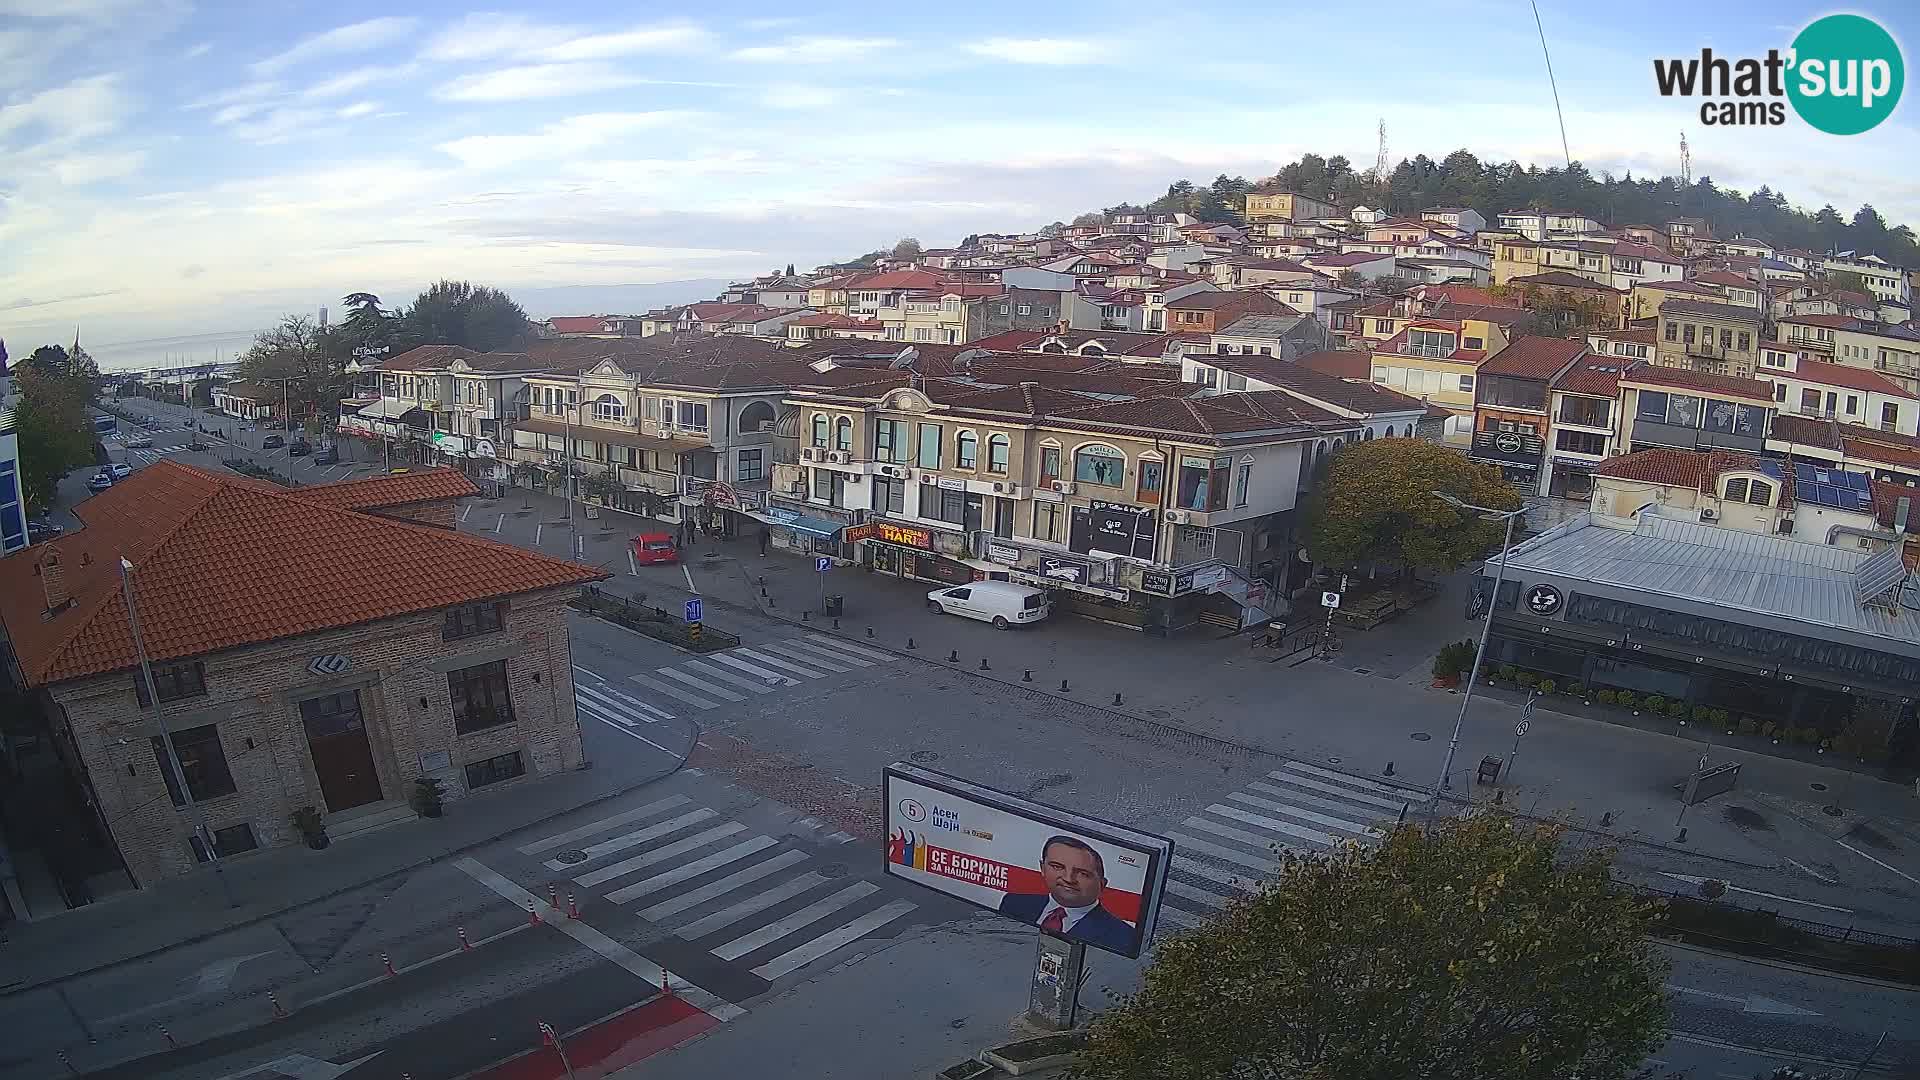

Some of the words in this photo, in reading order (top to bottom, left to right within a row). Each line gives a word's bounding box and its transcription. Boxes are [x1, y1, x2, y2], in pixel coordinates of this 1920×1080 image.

[908, 804, 917, 817] 5
[932, 805, 959, 820] Асен
[932, 816, 960, 832] Шајн
[931, 850, 948, 864] СЕ
[952, 854, 1009, 879] БОРИМЕ
[930, 862, 942, 872] ЗА
[944, 866, 981, 882] НАШИОТ
[983, 876, 1008, 889] ДОМ!
